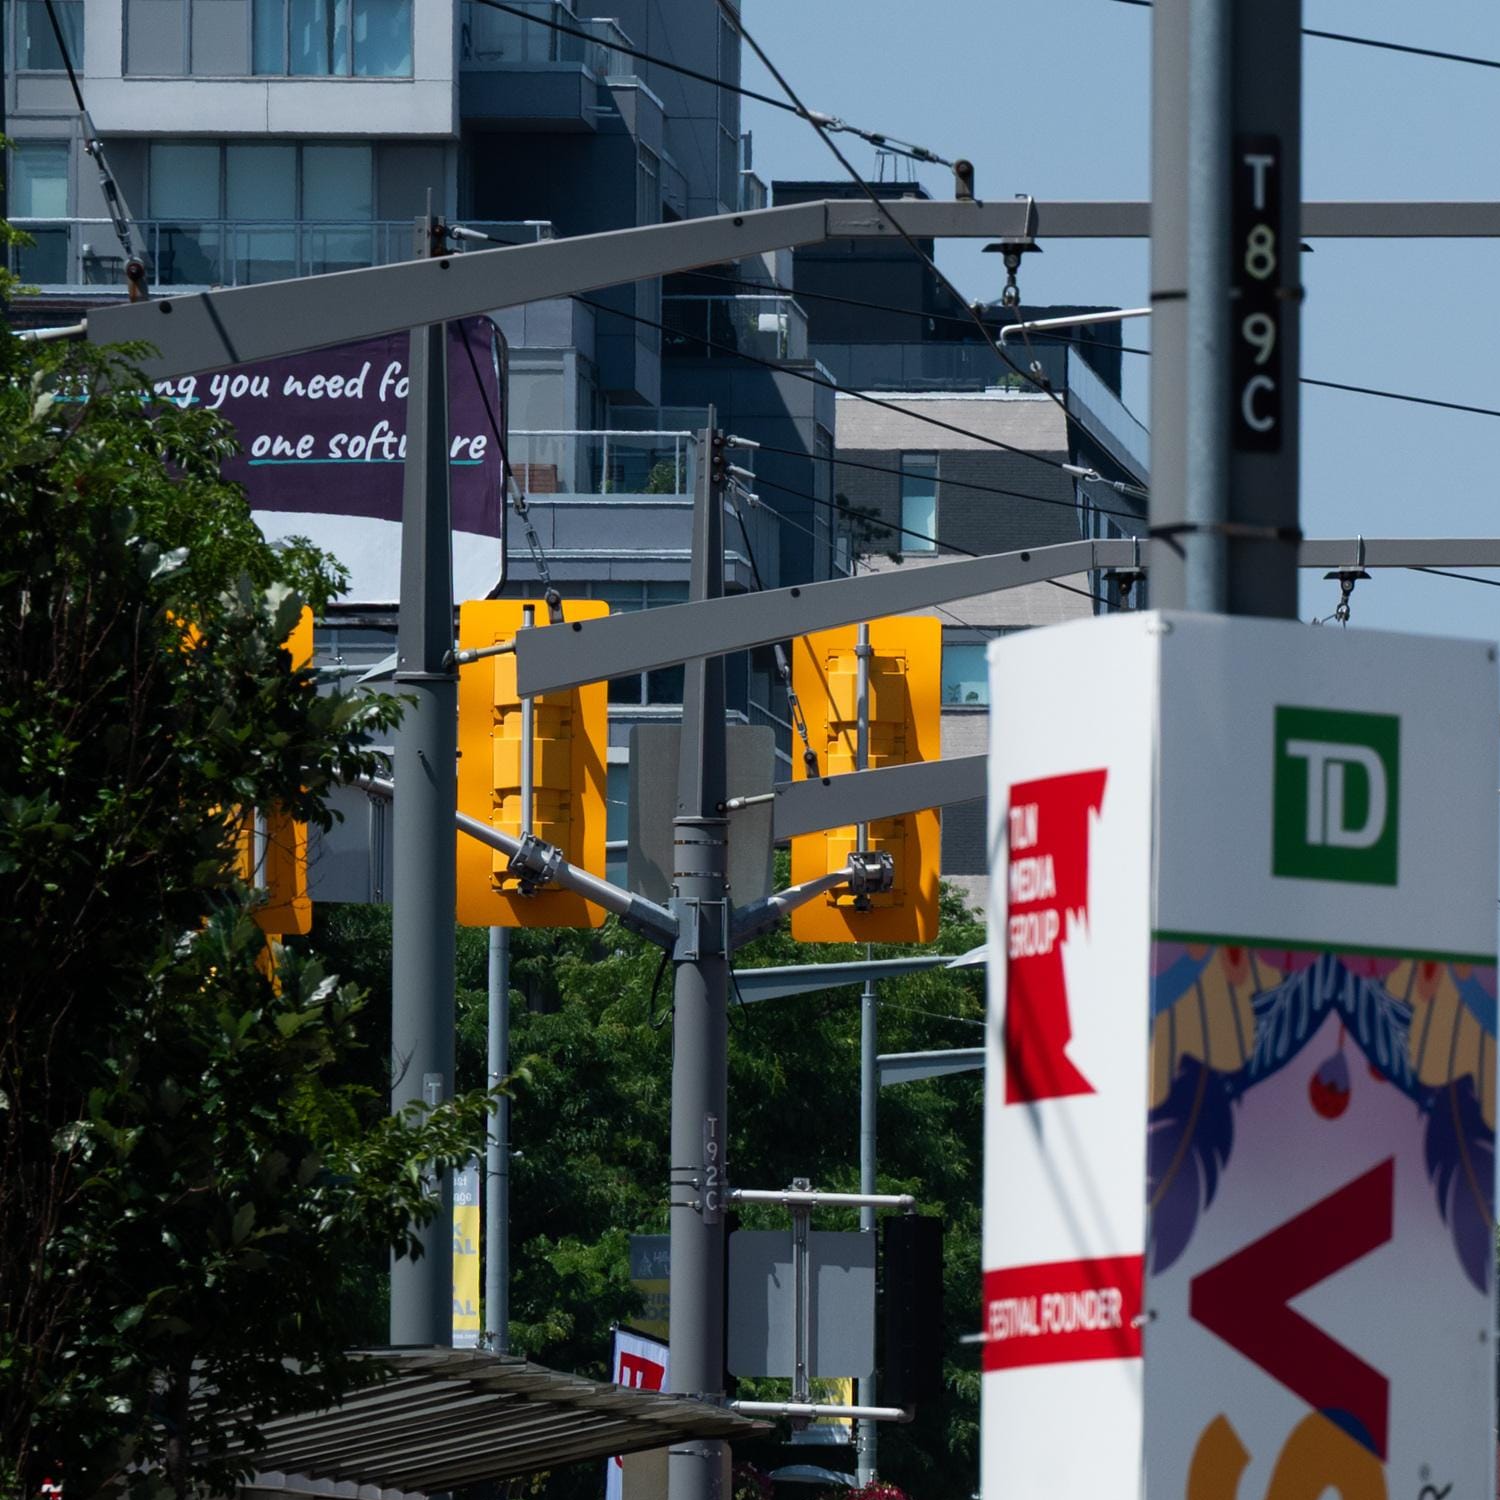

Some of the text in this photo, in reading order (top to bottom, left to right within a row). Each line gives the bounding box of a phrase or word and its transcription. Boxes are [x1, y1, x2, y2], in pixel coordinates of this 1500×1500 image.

[1240, 154, 1278, 432] T89C
[205, 373, 269, 410] you
[283, 362, 371, 400] need
[379, 361, 410, 401] fo
[251, 433, 314, 459] one
[1285, 739, 1388, 849] TD
[1040, 1288, 1122, 1334] FOUNDER
